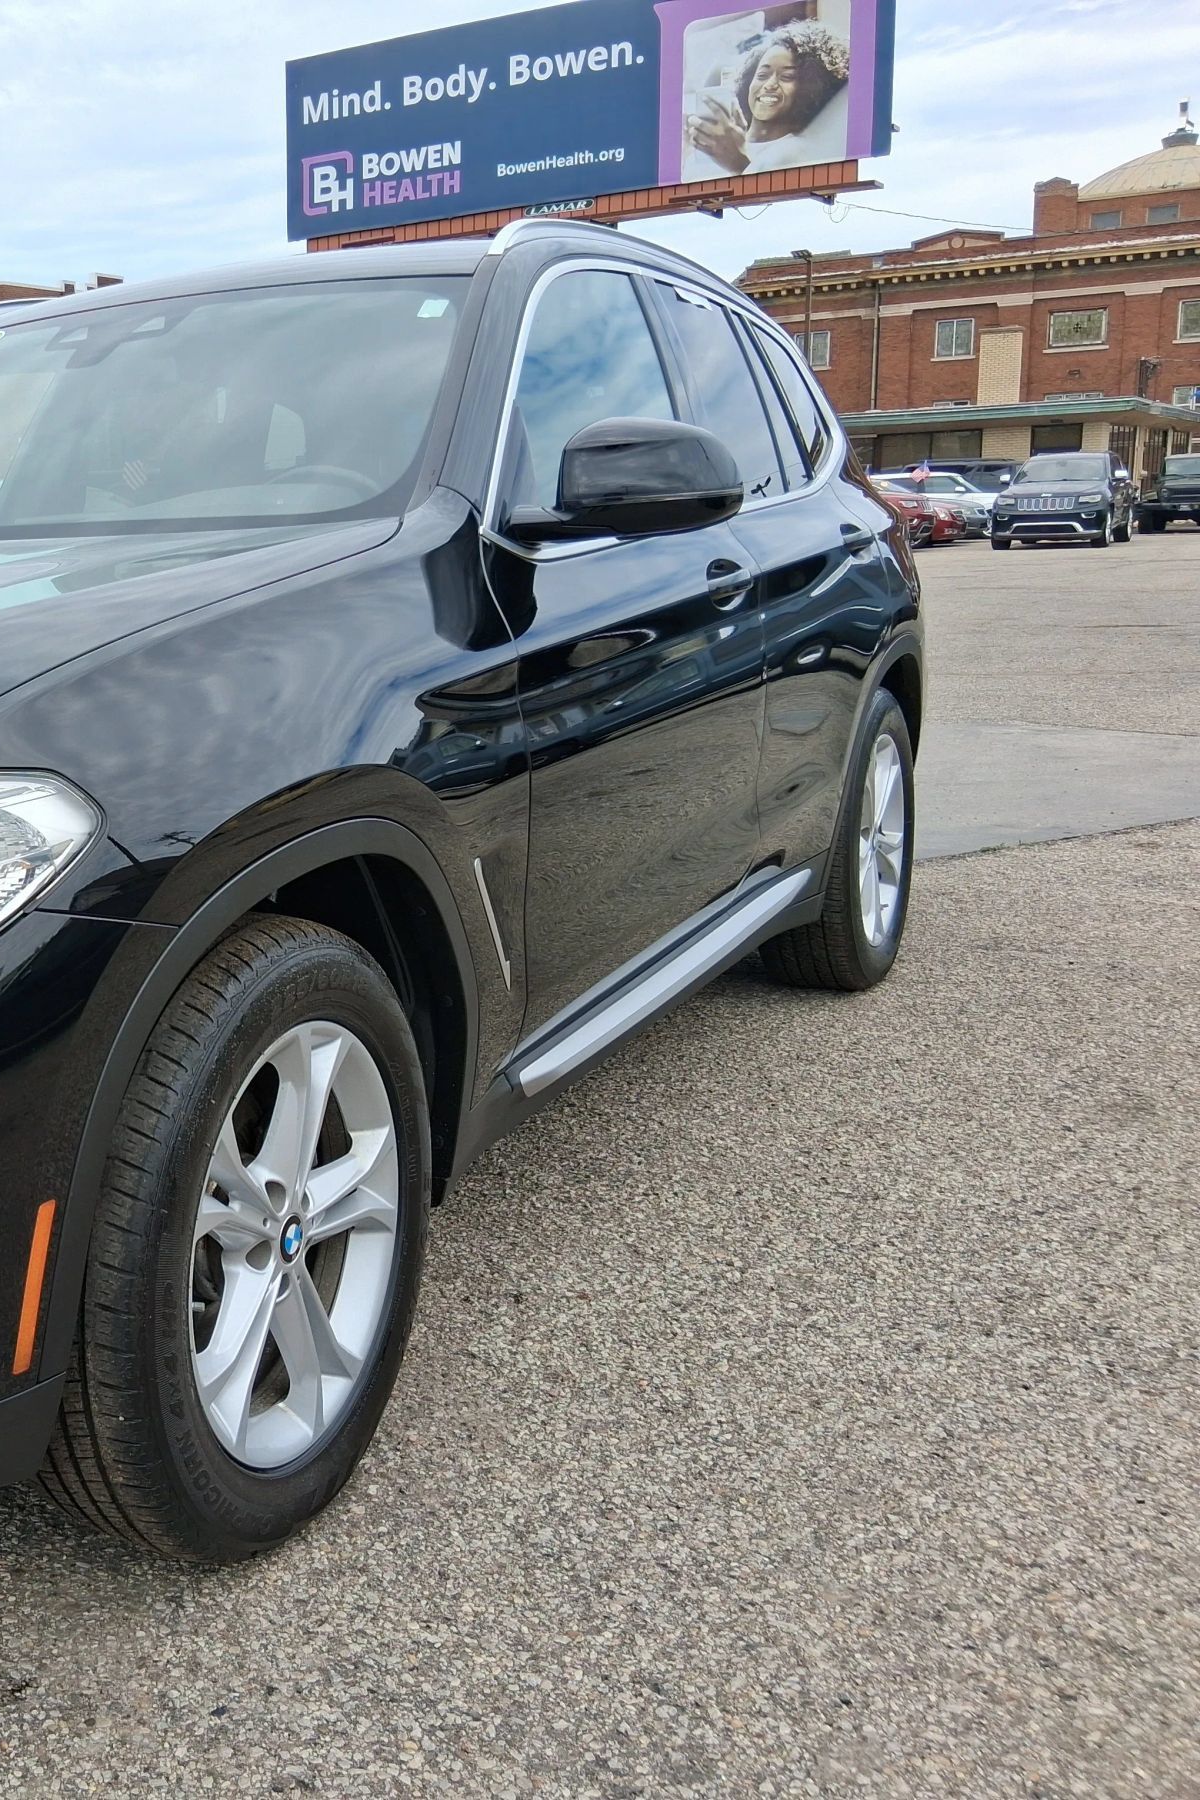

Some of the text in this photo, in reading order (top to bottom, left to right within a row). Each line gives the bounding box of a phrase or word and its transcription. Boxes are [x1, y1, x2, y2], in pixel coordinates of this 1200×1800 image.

[303, 41, 645, 125] Mind. Body. Bowen.
[362, 140, 462, 180] BOWEN
[497, 147, 626, 177] BowenHealth.org
[363, 170, 461, 208] HEALTH
[529, 200, 587, 216] LAMAR
